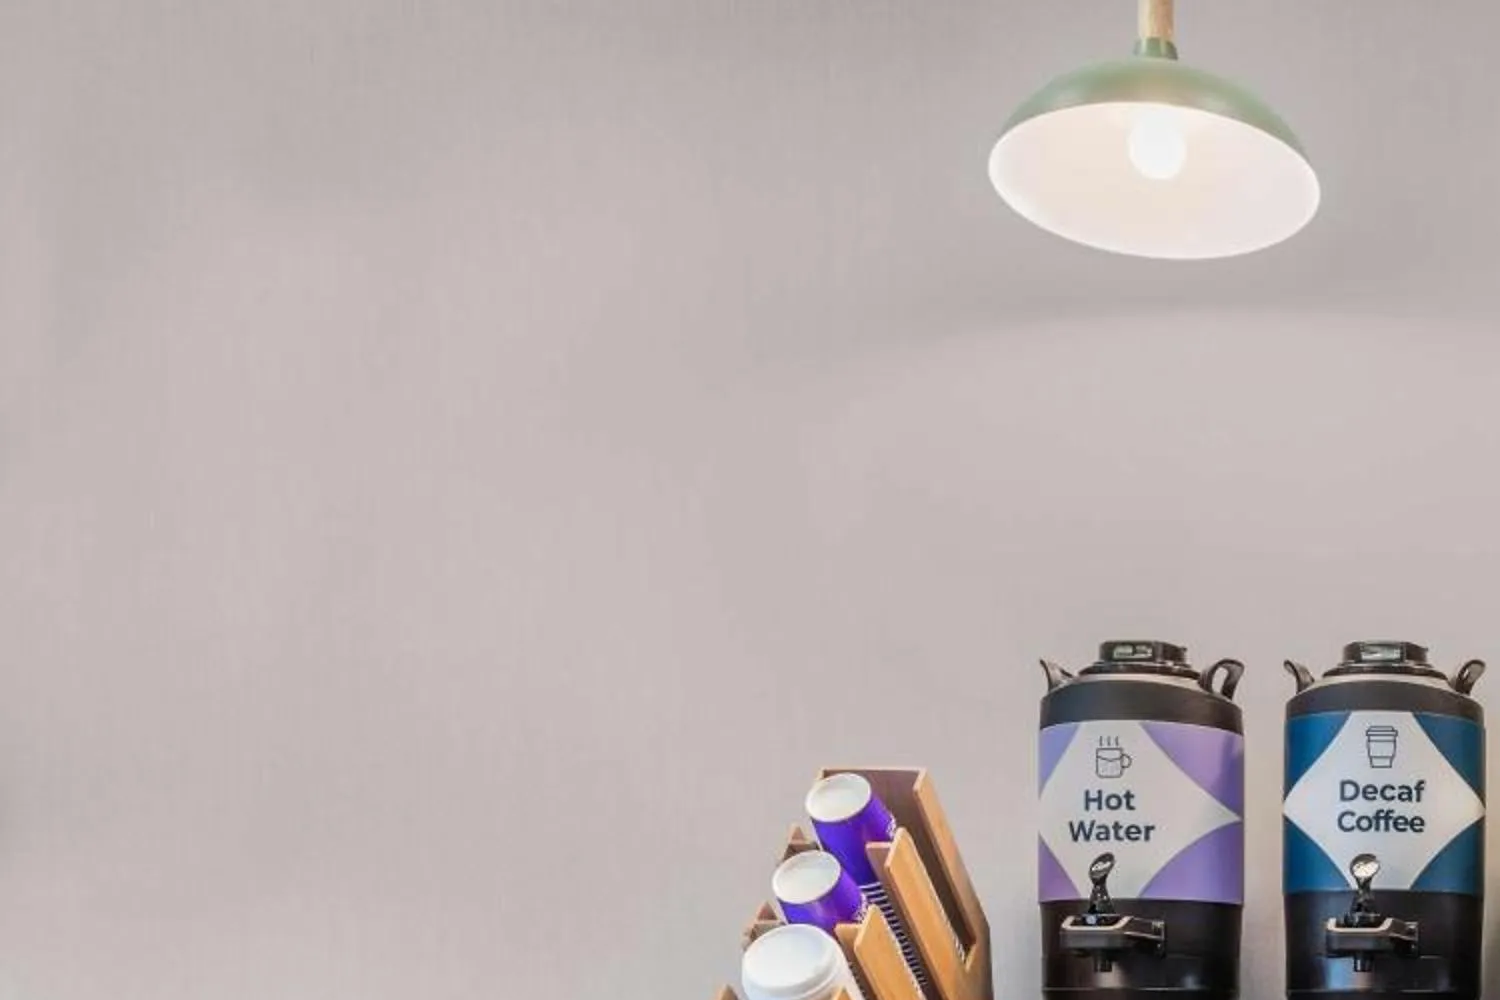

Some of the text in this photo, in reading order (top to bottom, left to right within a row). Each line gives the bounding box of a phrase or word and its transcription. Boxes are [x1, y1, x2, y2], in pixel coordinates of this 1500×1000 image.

[1084, 789, 1136, 811] Hot
[1339, 779, 1426, 802] Decaf
[1068, 819, 1156, 842] Water
[1337, 808, 1426, 833] Coffee
